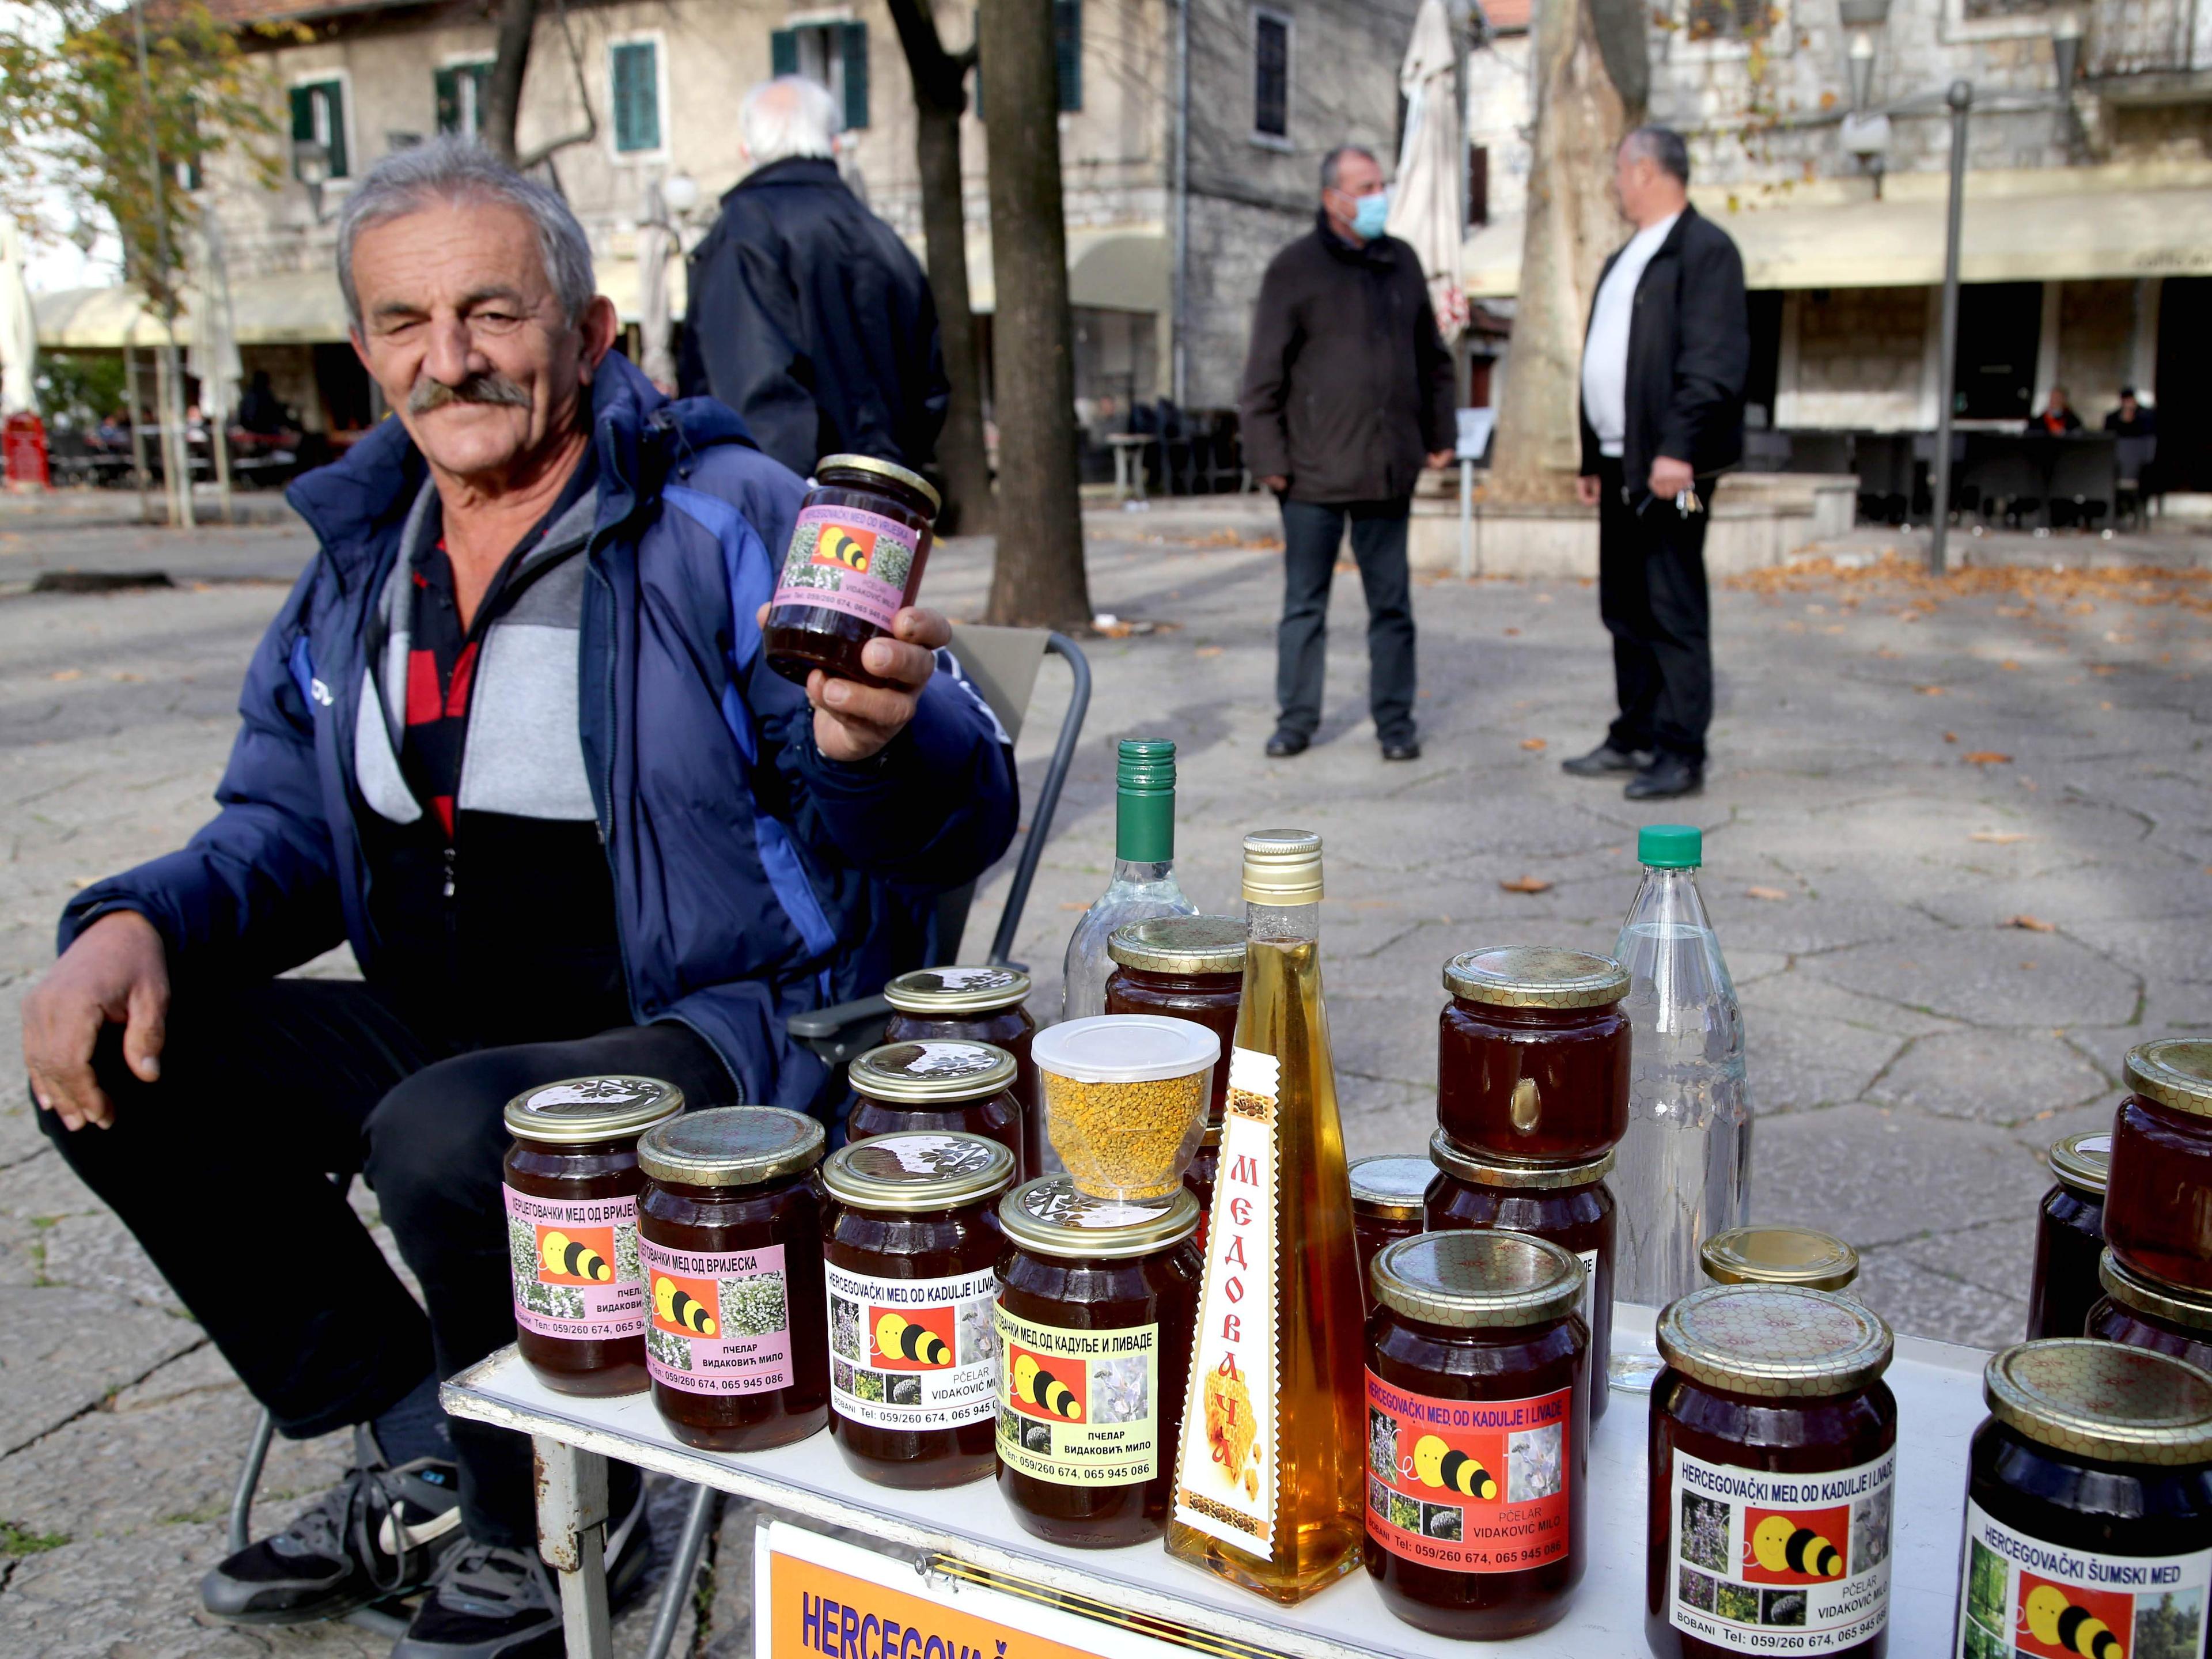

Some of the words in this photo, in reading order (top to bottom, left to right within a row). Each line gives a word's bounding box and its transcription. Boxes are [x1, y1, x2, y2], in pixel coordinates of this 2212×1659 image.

[850, 513, 864, 523] MED
[867, 516, 877, 527] OD
[512, 1197, 563, 1220] ХЕРЦЕГОВАЧКИ
[566, 1207, 586, 1222] МЕД
[588, 1208, 601, 1222] ОД
[672, 1255, 690, 1274] МЕД
[691, 1259, 706, 1275] ОД
[707, 1255, 758, 1273] ВРИЈЕСКА
[828, 1270, 885, 1301] HERCEGOVAČKI
[887, 1287, 908, 1302] MED
[911, 1288, 925, 1302] OD
[928, 1282, 971, 1302] KADULJE
[597, 1301, 642, 1313] ВИДАКОВИ
[535, 1319, 551, 1331] Тел:
[553, 1323, 589, 1334] 059/260
[616, 1322, 634, 1333] 065
[723, 1344, 757, 1354] ПЧЕЛАР
[1021, 1326, 1037, 1348] МЕД
[1039, 1334, 1053, 1351] ОД
[1055, 1335, 1099, 1355] КАДУЉЕ
[1102, 1338, 1109, 1353] И
[1112, 1332, 1153, 1352] ЛИВАДЕ
[703, 1357, 757, 1369] ВИДАКОВИЋ
[759, 1353, 783, 1364] МИЛО
[665, 1370, 696, 1387] 059/260
[722, 1378, 740, 1389] 065
[744, 1377, 762, 1388] 945
[765, 1373, 783, 1384] 086
[953, 1366, 989, 1384] PČELAR
[931, 1380, 984, 1400] VIDAKOVIĆ
[860, 1407, 877, 1420] Tel:
[880, 1414, 922, 1424] 059/260
[925, 1413, 948, 1423] 674,
[952, 1408, 971, 1421] 065
[973, 1402, 990, 1416] 945
[1368, 1379, 1425, 1421] HERCEGOVAČKI
[1427, 1408, 1450, 1425] MED
[1453, 1410, 1469, 1426] OD
[1473, 1409, 1523, 1427] KADULJE
[1531, 1400, 1563, 1423] LIVADE
[1088, 1431, 1126, 1441] ПЧЕЛАР
[1065, 1444, 1123, 1456] ВИДАКОВИЋ
[1126, 1441, 1151, 1453] МИЛО
[1004, 1445, 1018, 1463] Тел:
[1020, 1456, 1055, 1475] 059/260
[1058, 1467, 1081, 1480] 674,
[1084, 1469, 1104, 1479] 065
[1108, 1467, 1128, 1479] 945
[1131, 1463, 1150, 1476] 086
[1681, 1461, 1768, 1502] HERCEGOVAČKI
[1771, 1484, 1798, 1503] MED
[1801, 1484, 1819, 1502] OD
[1822, 1473, 1868, 1501] KADULJE
[1499, 1506, 1542, 1523] PČELAR
[1474, 1521, 1535, 1539] VIDAKOVIĆ
[1538, 1515, 1560, 1532] MILO
[1368, 1516, 1391, 1542] BOBANI
[1394, 1535, 1412, 1552] Tel:
[1415, 1544, 1461, 1563] 059/260
[1465, 1553, 1491, 1565] 674,
[1495, 1552, 1518, 1563] 065
[1521, 1548, 1542, 1561] 945
[1544, 1541, 1562, 1555] 086
[1985, 1523, 2084, 1580] HERCEGOVAČKI
[2088, 1558, 2147, 1585] ŠUMSKI
[2151, 1565, 2181, 1585] MED
[1843, 1574, 1877, 1599] PČELAR
[1818, 1592, 1872, 1620] VIDAKOVIĆ
[1677, 1611, 1716, 1637] BOBANI
[1724, 1627, 1747, 1646] Tel:
[1751, 1634, 1805, 1650] 059/260
[1808, 1632, 1835, 1647] 674,
[1838, 1627, 1857, 1642] 065
[1859, 1617, 1875, 1635] 945
